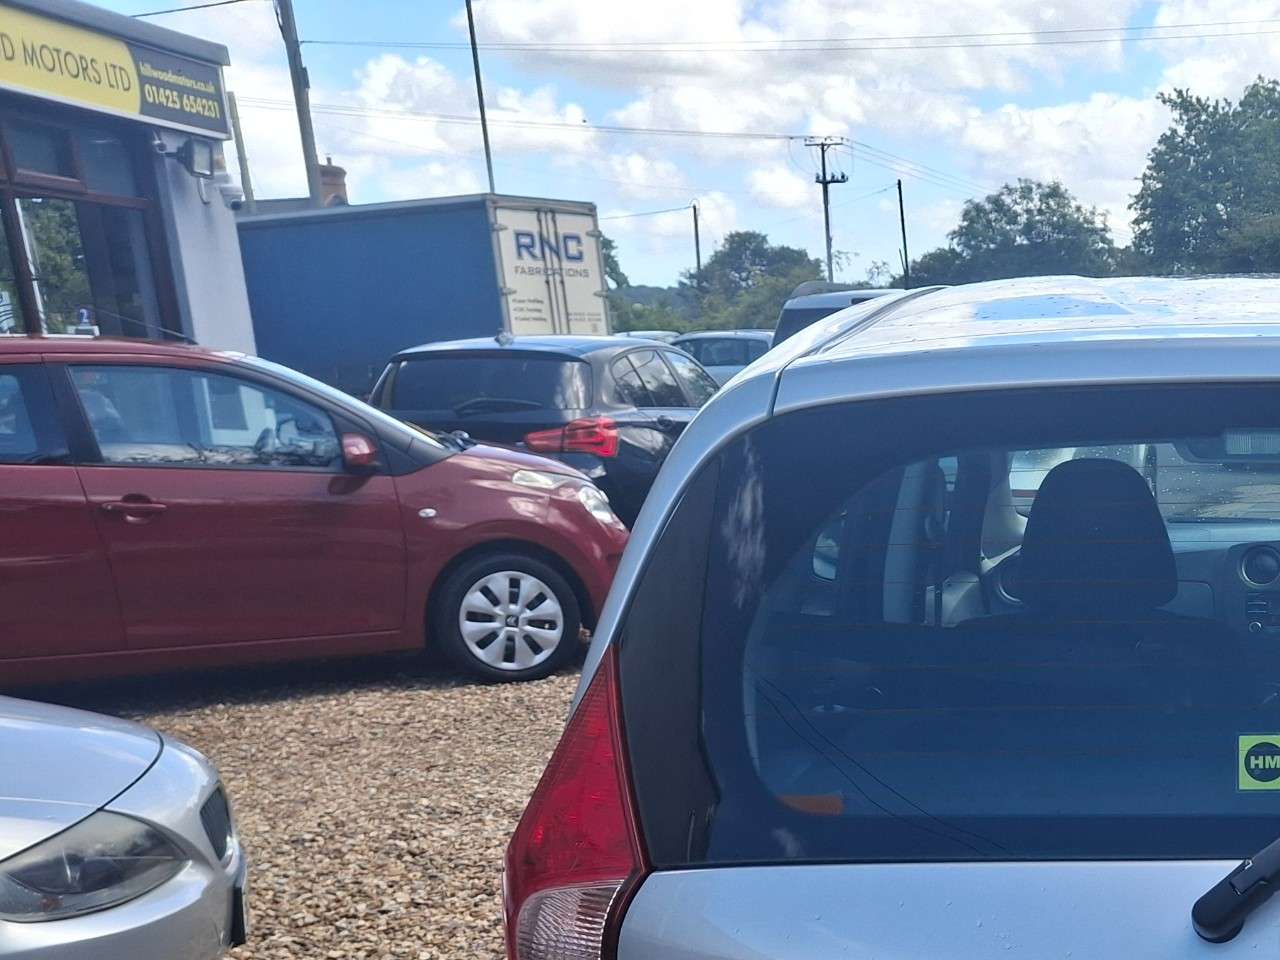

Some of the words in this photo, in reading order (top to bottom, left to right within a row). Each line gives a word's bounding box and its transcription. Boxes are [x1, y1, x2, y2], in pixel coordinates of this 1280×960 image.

[22, 36, 101, 85] MOTORS
[104, 62, 131, 92] LTD
[145, 83, 181, 110] 01425
[183, 94, 219, 119] 654231
[514, 231, 584, 261] RNC
[1250, 755, 1280, 769] HM
